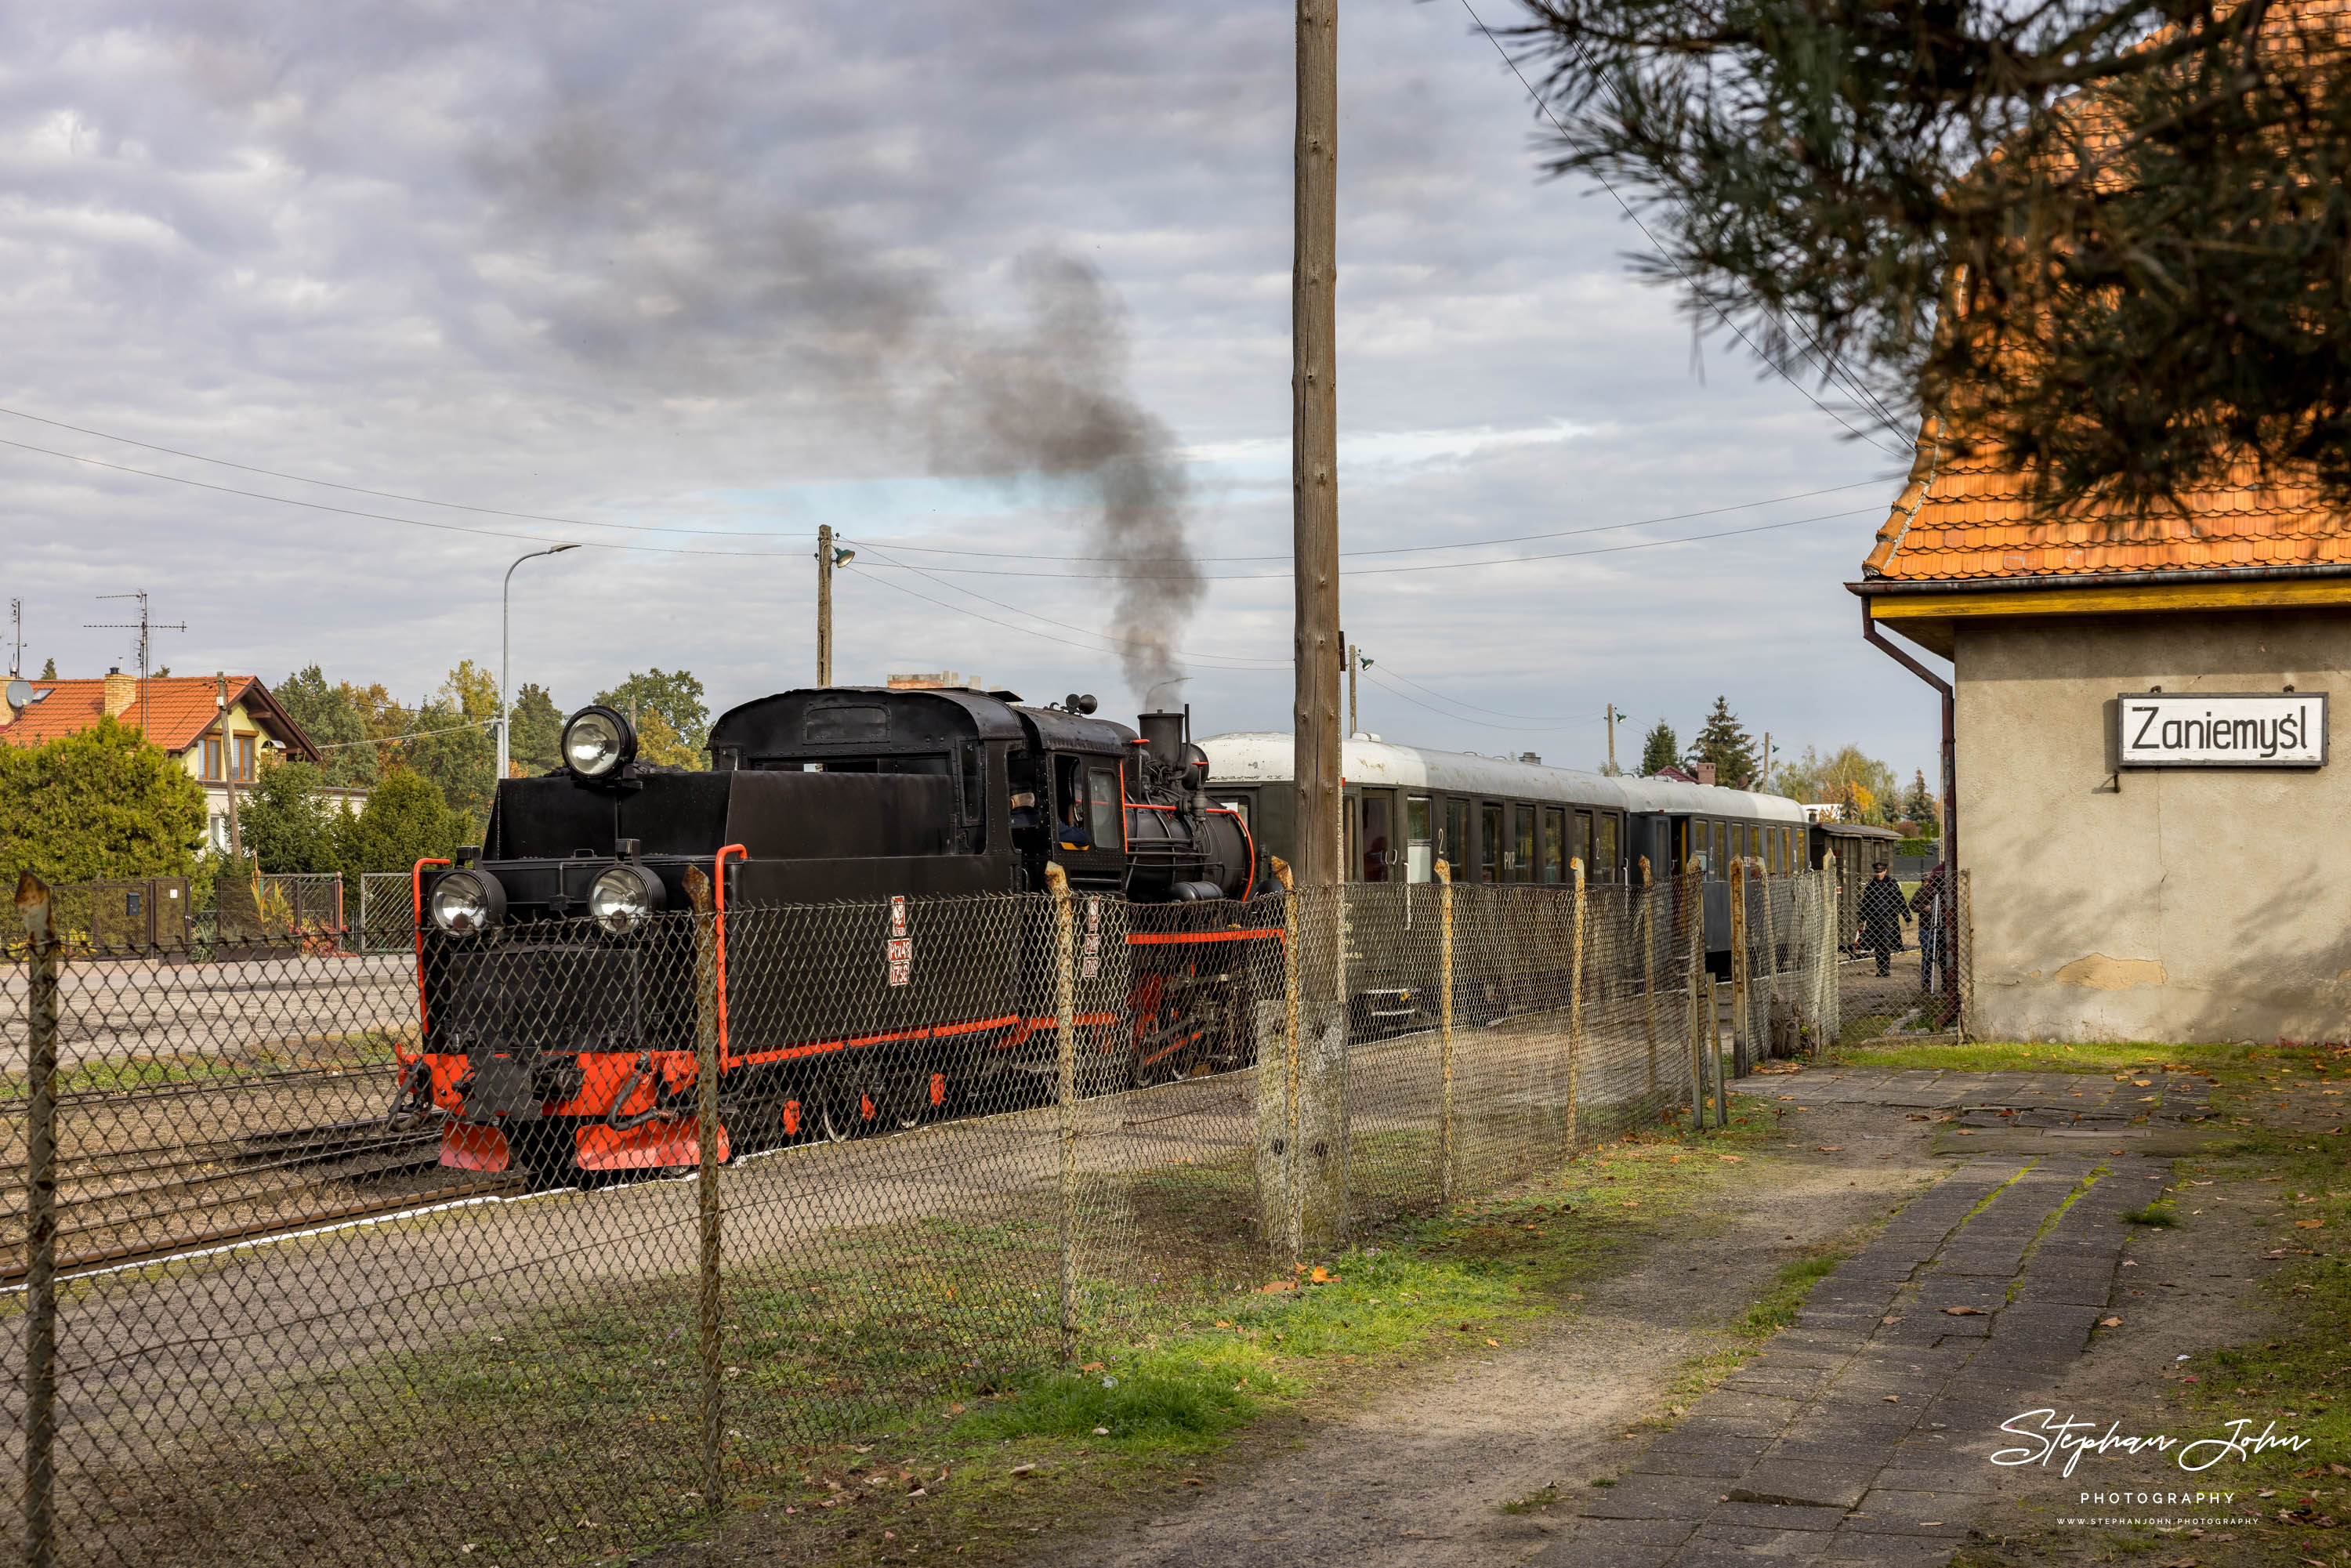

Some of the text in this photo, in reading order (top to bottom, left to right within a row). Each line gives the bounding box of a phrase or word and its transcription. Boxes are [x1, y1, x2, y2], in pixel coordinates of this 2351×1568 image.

[2132, 705, 2308, 758] Zaniemyśl
[1438, 827, 1444, 855] 2
[1596, 837, 1600, 860] 2
[1504, 851, 1516, 870] PKP
